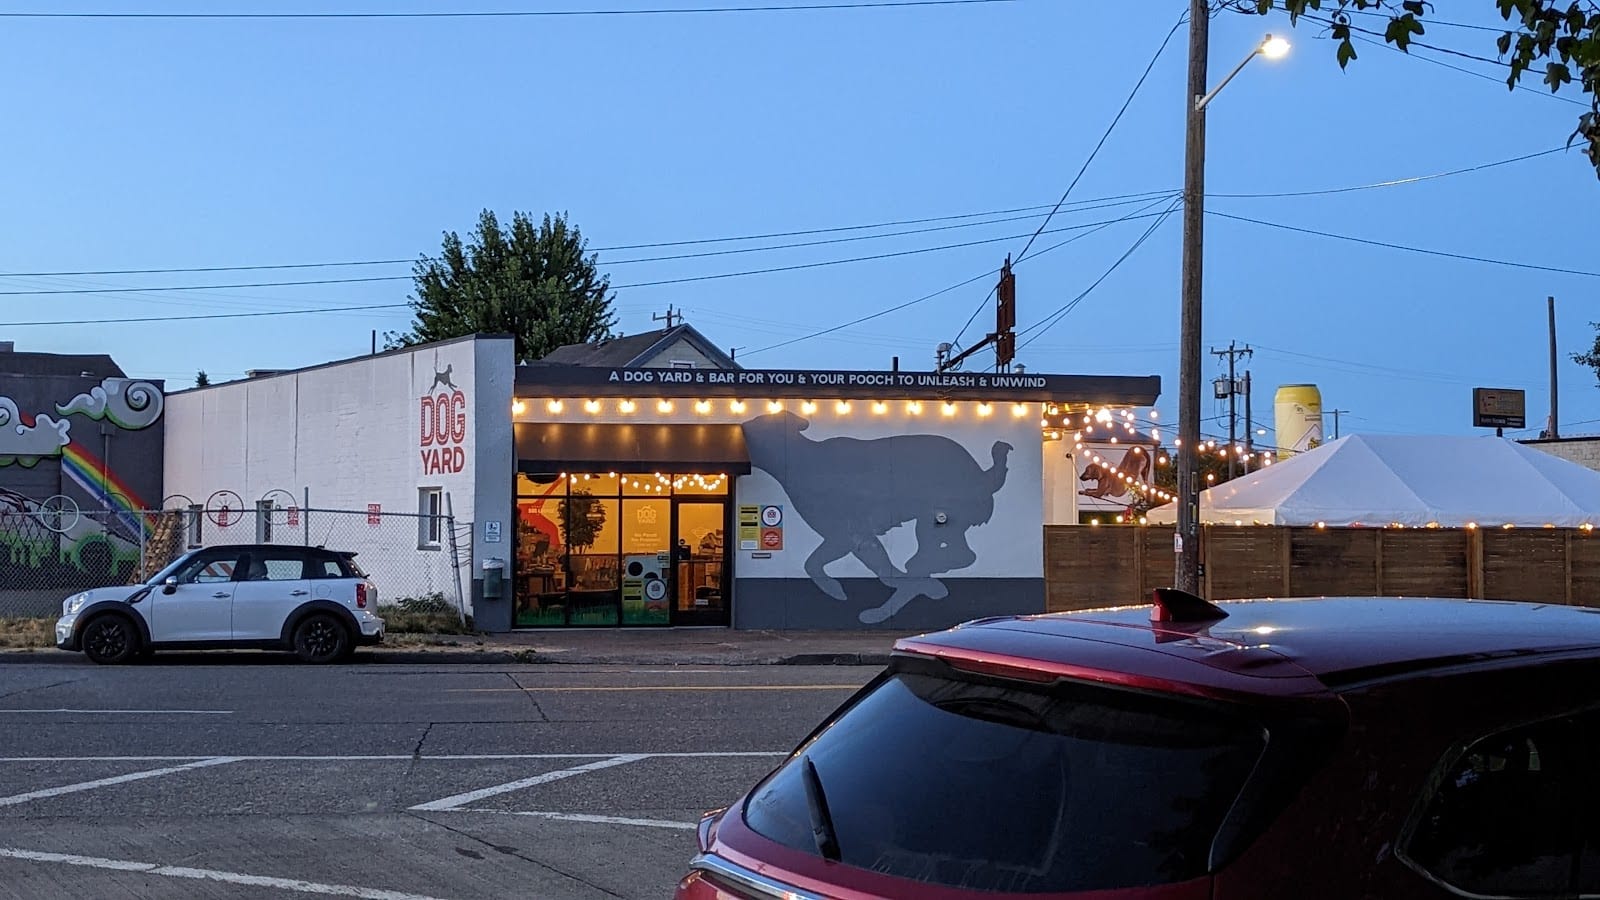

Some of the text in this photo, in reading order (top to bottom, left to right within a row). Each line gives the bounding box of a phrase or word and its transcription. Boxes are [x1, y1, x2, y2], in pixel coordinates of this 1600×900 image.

[608, 370, 1047, 388] A DOG YARD & BAR FOR YOU & YOUR POOCH TO UNLEASH & UNWIND
[420, 390, 466, 447] DOG
[420, 446, 465, 475] YARD
[637, 509, 657, 520] DOG
